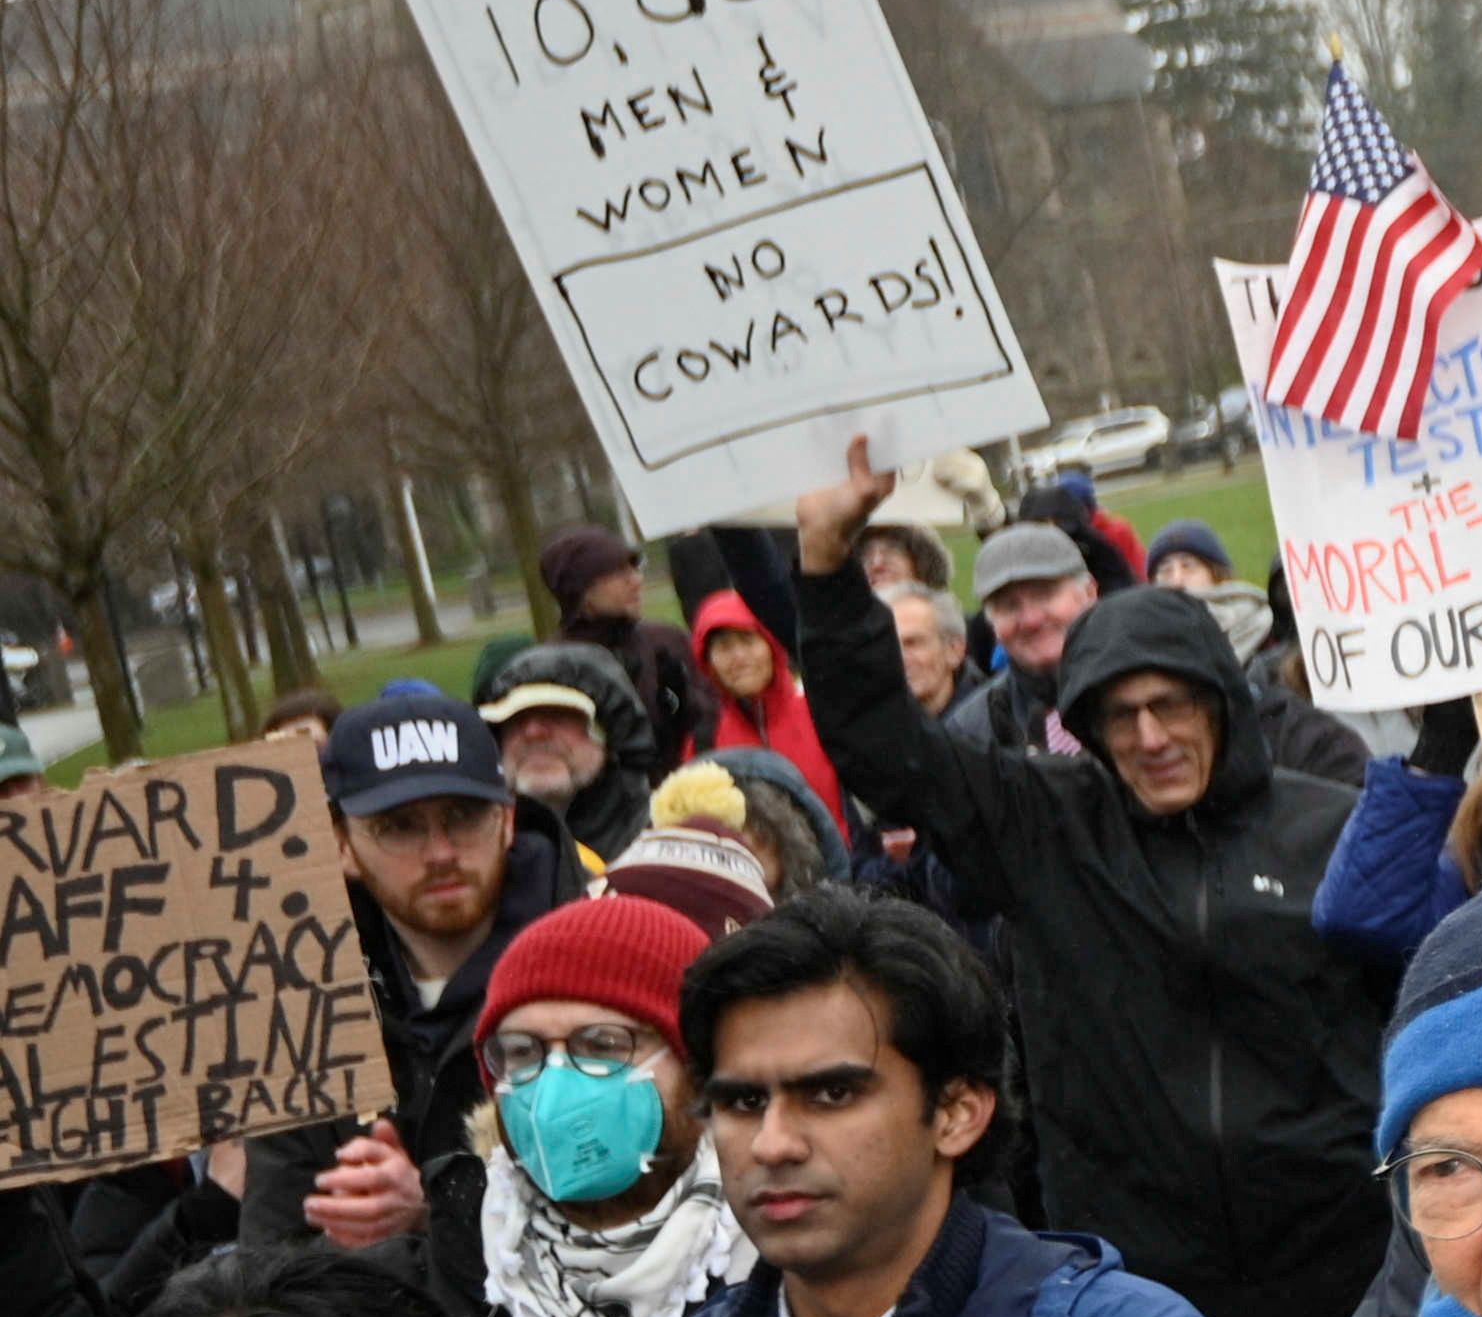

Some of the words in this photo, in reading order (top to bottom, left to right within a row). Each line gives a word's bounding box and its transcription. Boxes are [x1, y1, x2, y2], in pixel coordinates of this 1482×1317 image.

[580, 67, 714, 158] MEN
[757, 32, 799, 120] &
[576, 127, 830, 233] WOMEN
[704, 239, 786, 302] NO
[633, 237, 966, 402] COWARDS!
[1389, 482, 1479, 533] THE
[1283, 530, 1472, 616] MORAL
[1311, 625, 1367, 691] OF
[371, 719, 459, 771] UAW
[197, 1069, 357, 1142] BACK!
